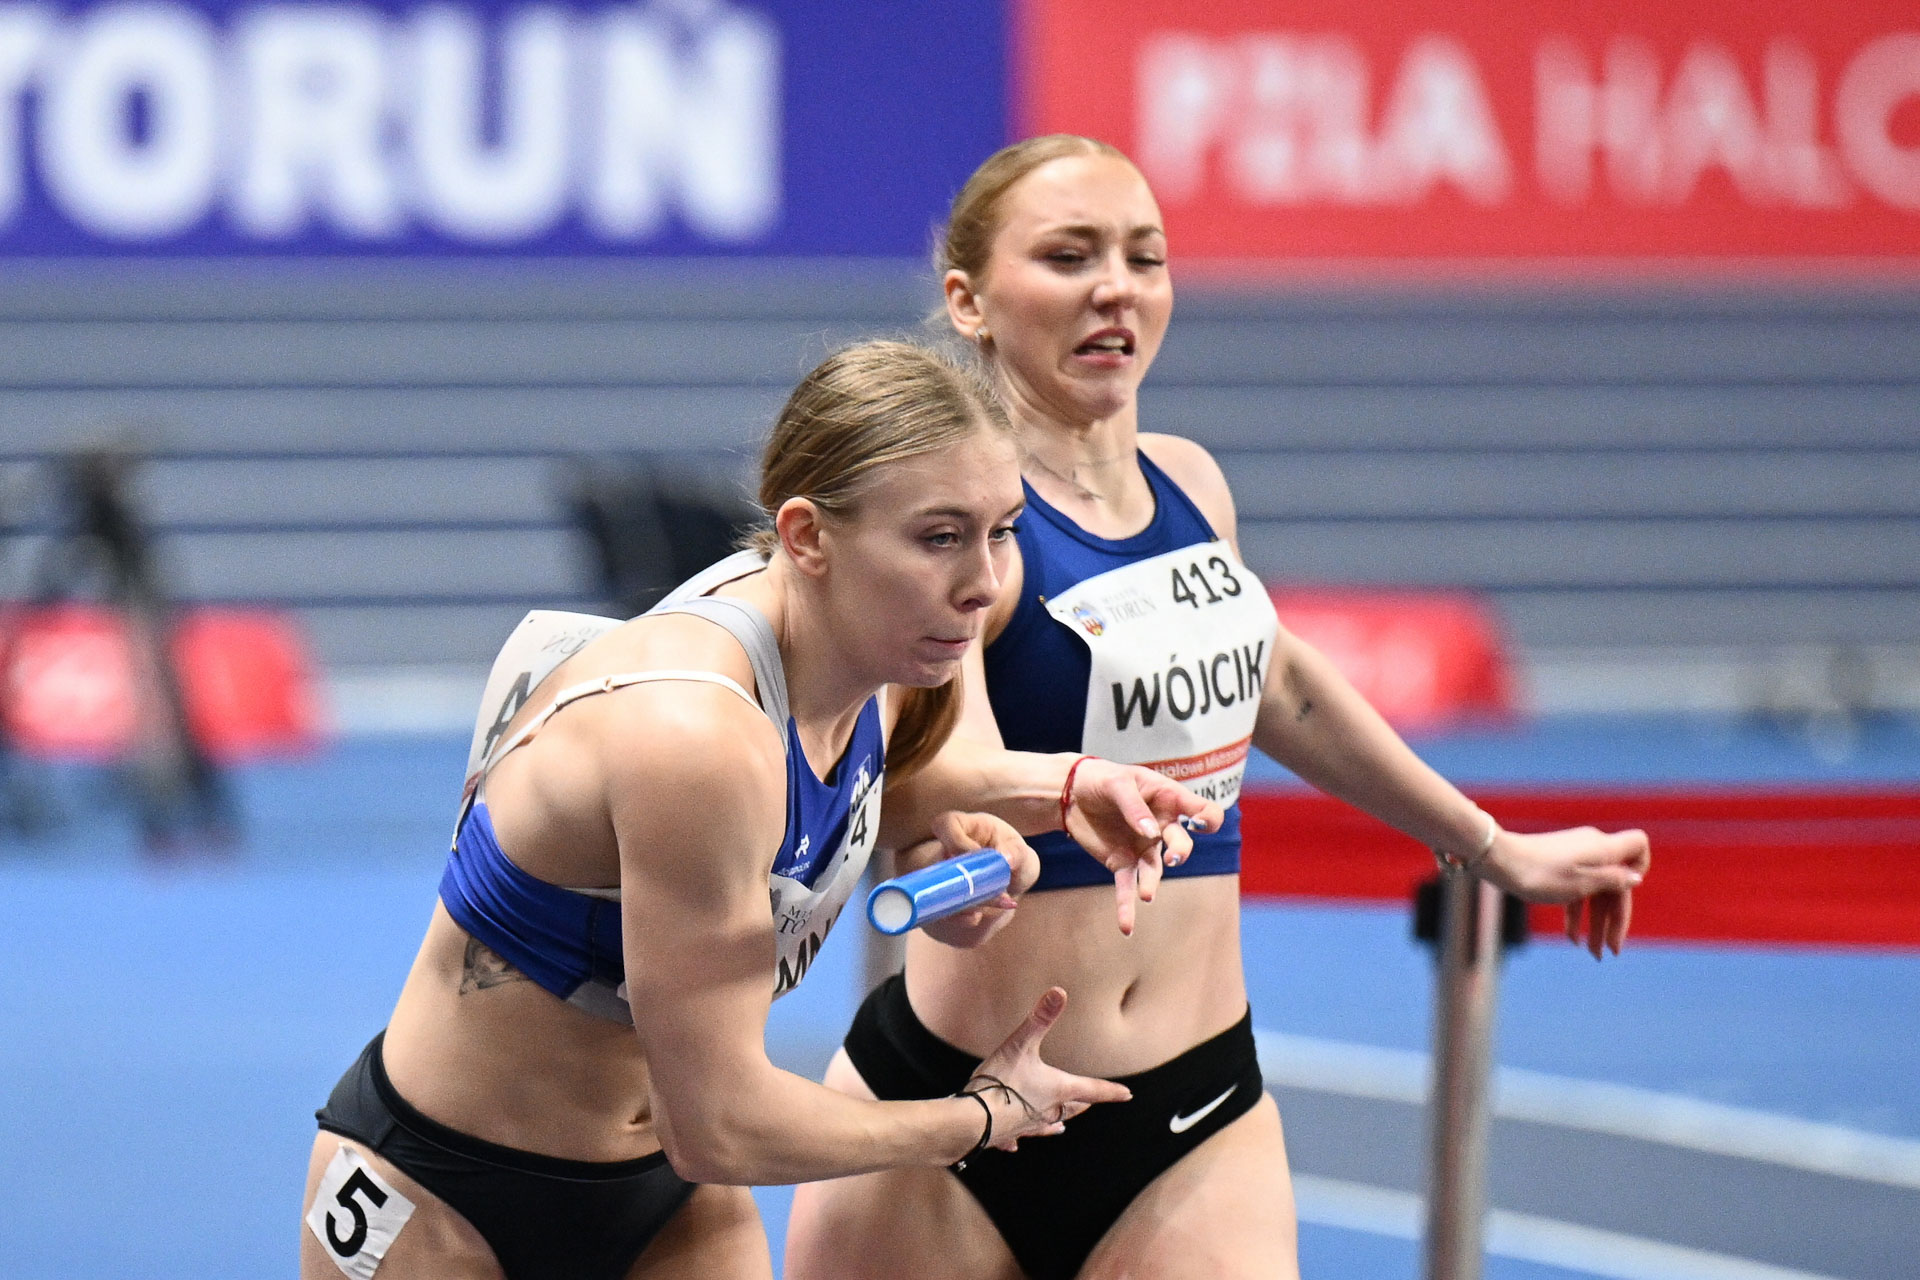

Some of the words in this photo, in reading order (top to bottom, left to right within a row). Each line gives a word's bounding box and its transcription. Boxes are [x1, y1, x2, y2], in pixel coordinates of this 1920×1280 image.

[1172, 556, 1242, 609] 413
[1111, 640, 1264, 731] WÓJCIK
[325, 1166, 389, 1258] 5
